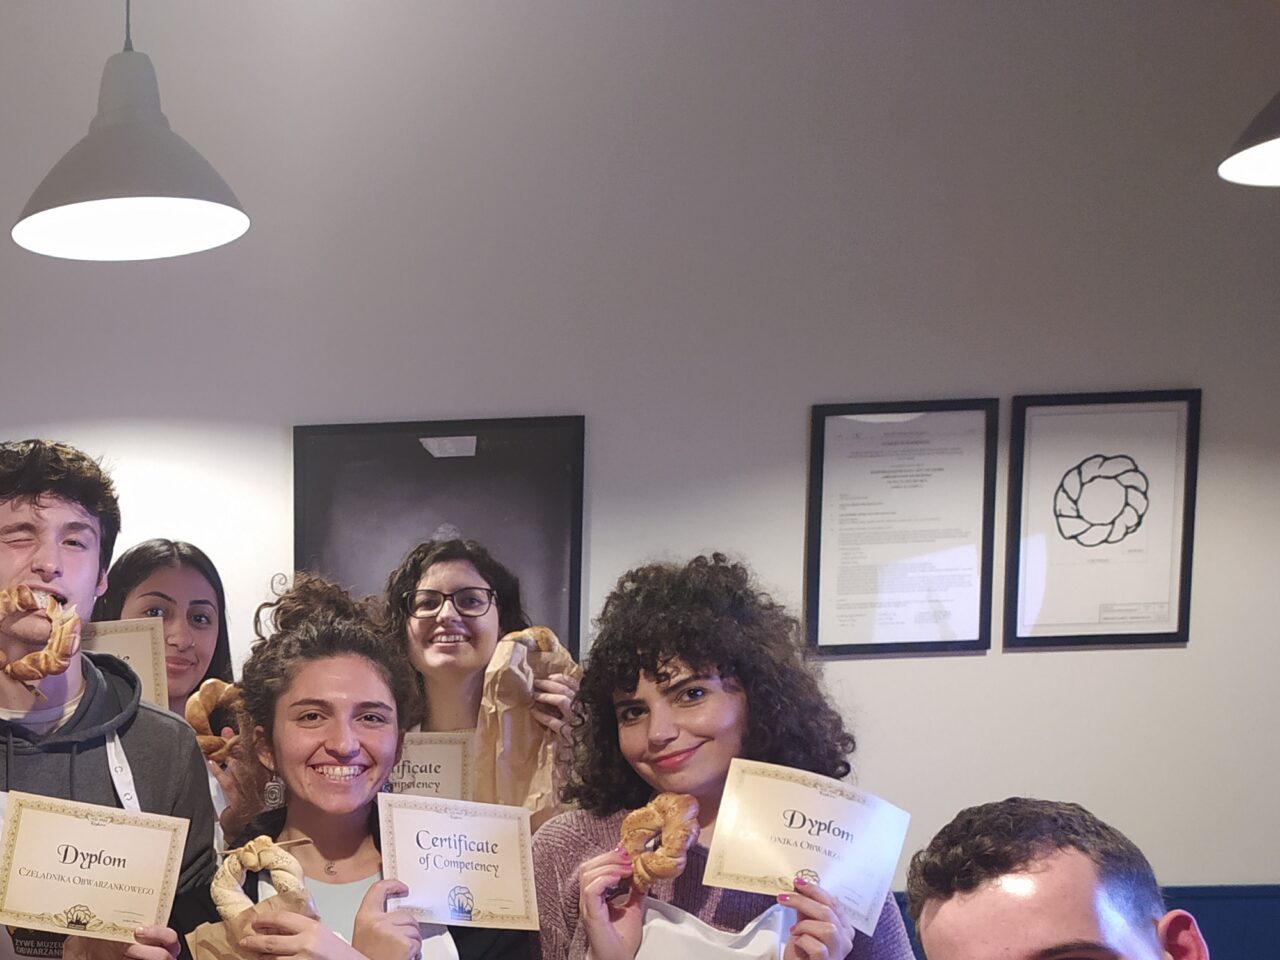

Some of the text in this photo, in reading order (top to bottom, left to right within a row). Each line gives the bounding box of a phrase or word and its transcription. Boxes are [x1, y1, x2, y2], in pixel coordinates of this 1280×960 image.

[392, 760, 441, 779] tificate
[782, 809, 854, 844] Dyplom
[416, 830, 498, 857] Certificate
[57, 844, 127, 870] Dyplom
[419, 854, 500, 878] of Competency
[18, 866, 155, 896] CZELADNIKA OBWARZANKOWEGO
[16, 947, 63, 956] OBWARZAN
[37, 940, 64, 949] MUZEU
